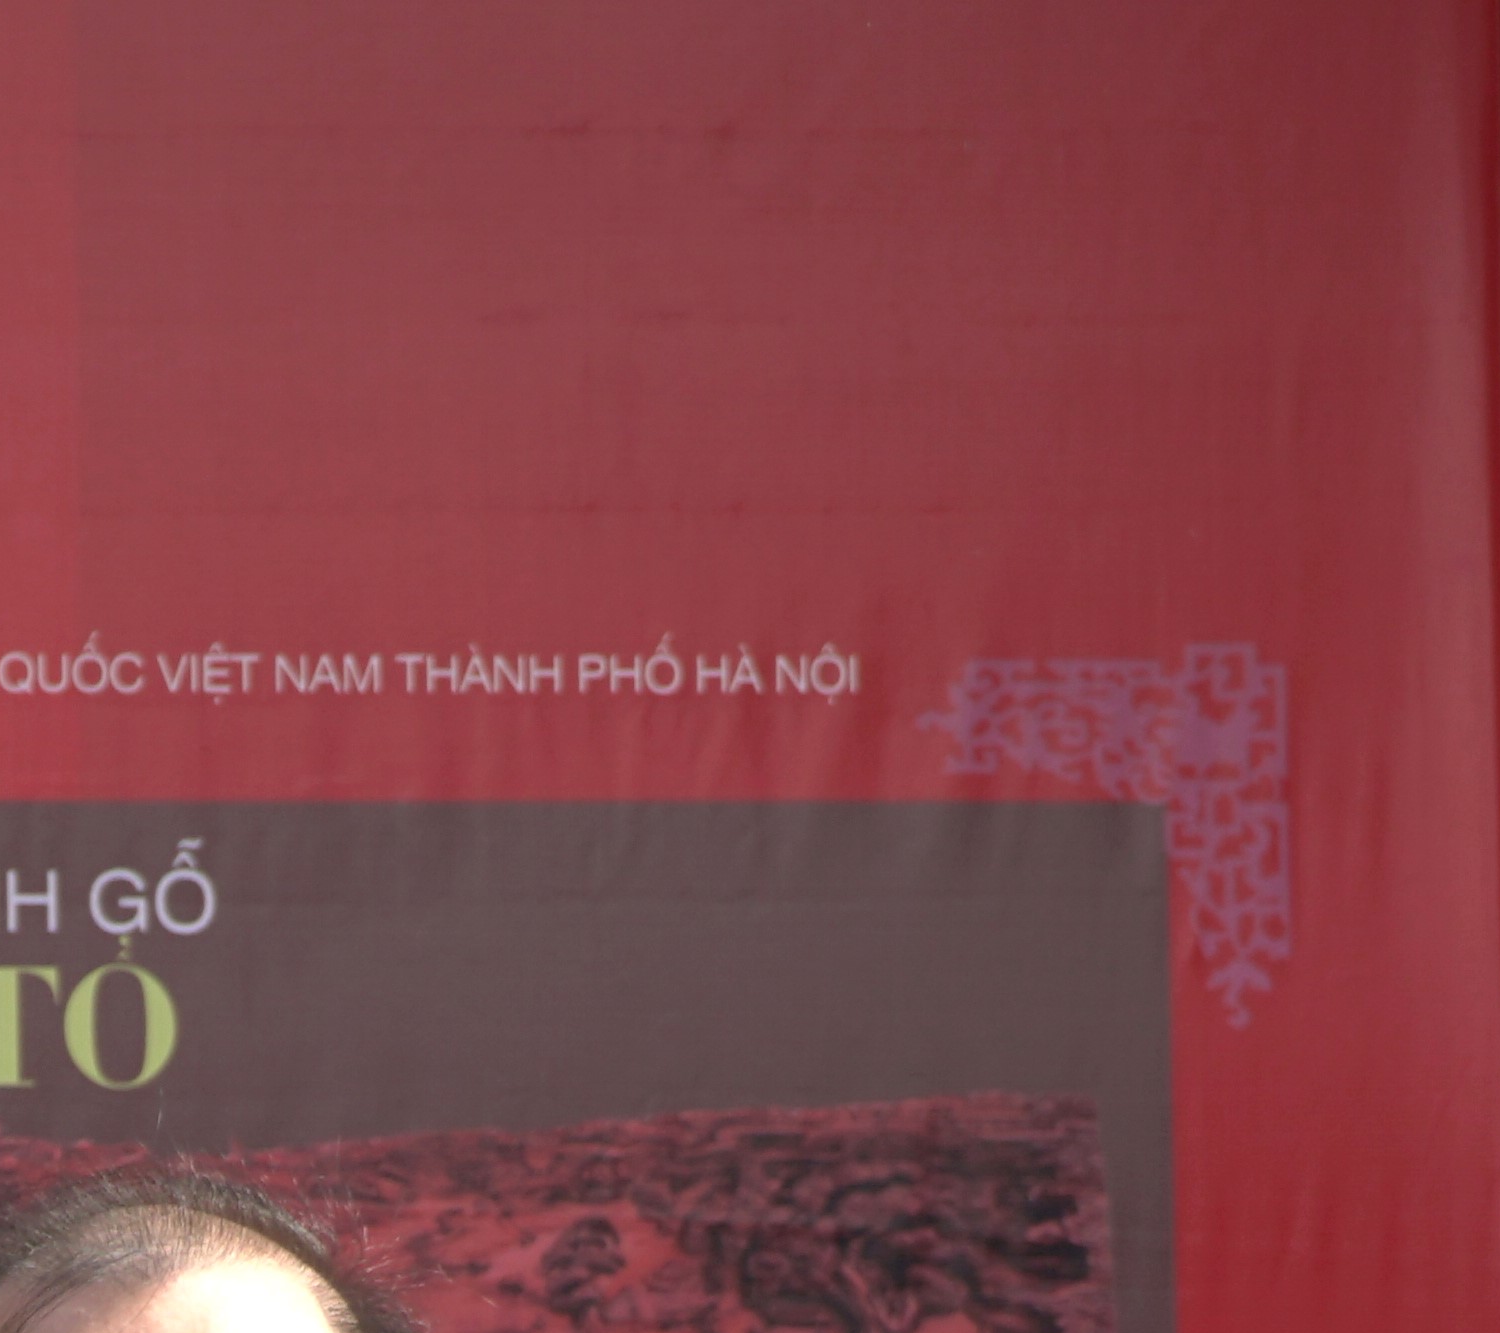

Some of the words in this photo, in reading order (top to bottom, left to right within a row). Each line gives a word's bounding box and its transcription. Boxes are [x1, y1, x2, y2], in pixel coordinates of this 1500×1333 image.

[155, 641, 263, 705] VIỆT
[273, 651, 385, 695] NAM
[393, 642, 566, 696] THÀNH
[576, 630, 686, 696] PHỐ
[694, 641, 765, 695] HÀ
[773, 641, 861, 706] NỘI
[87, 836, 218, 936] GỖ
